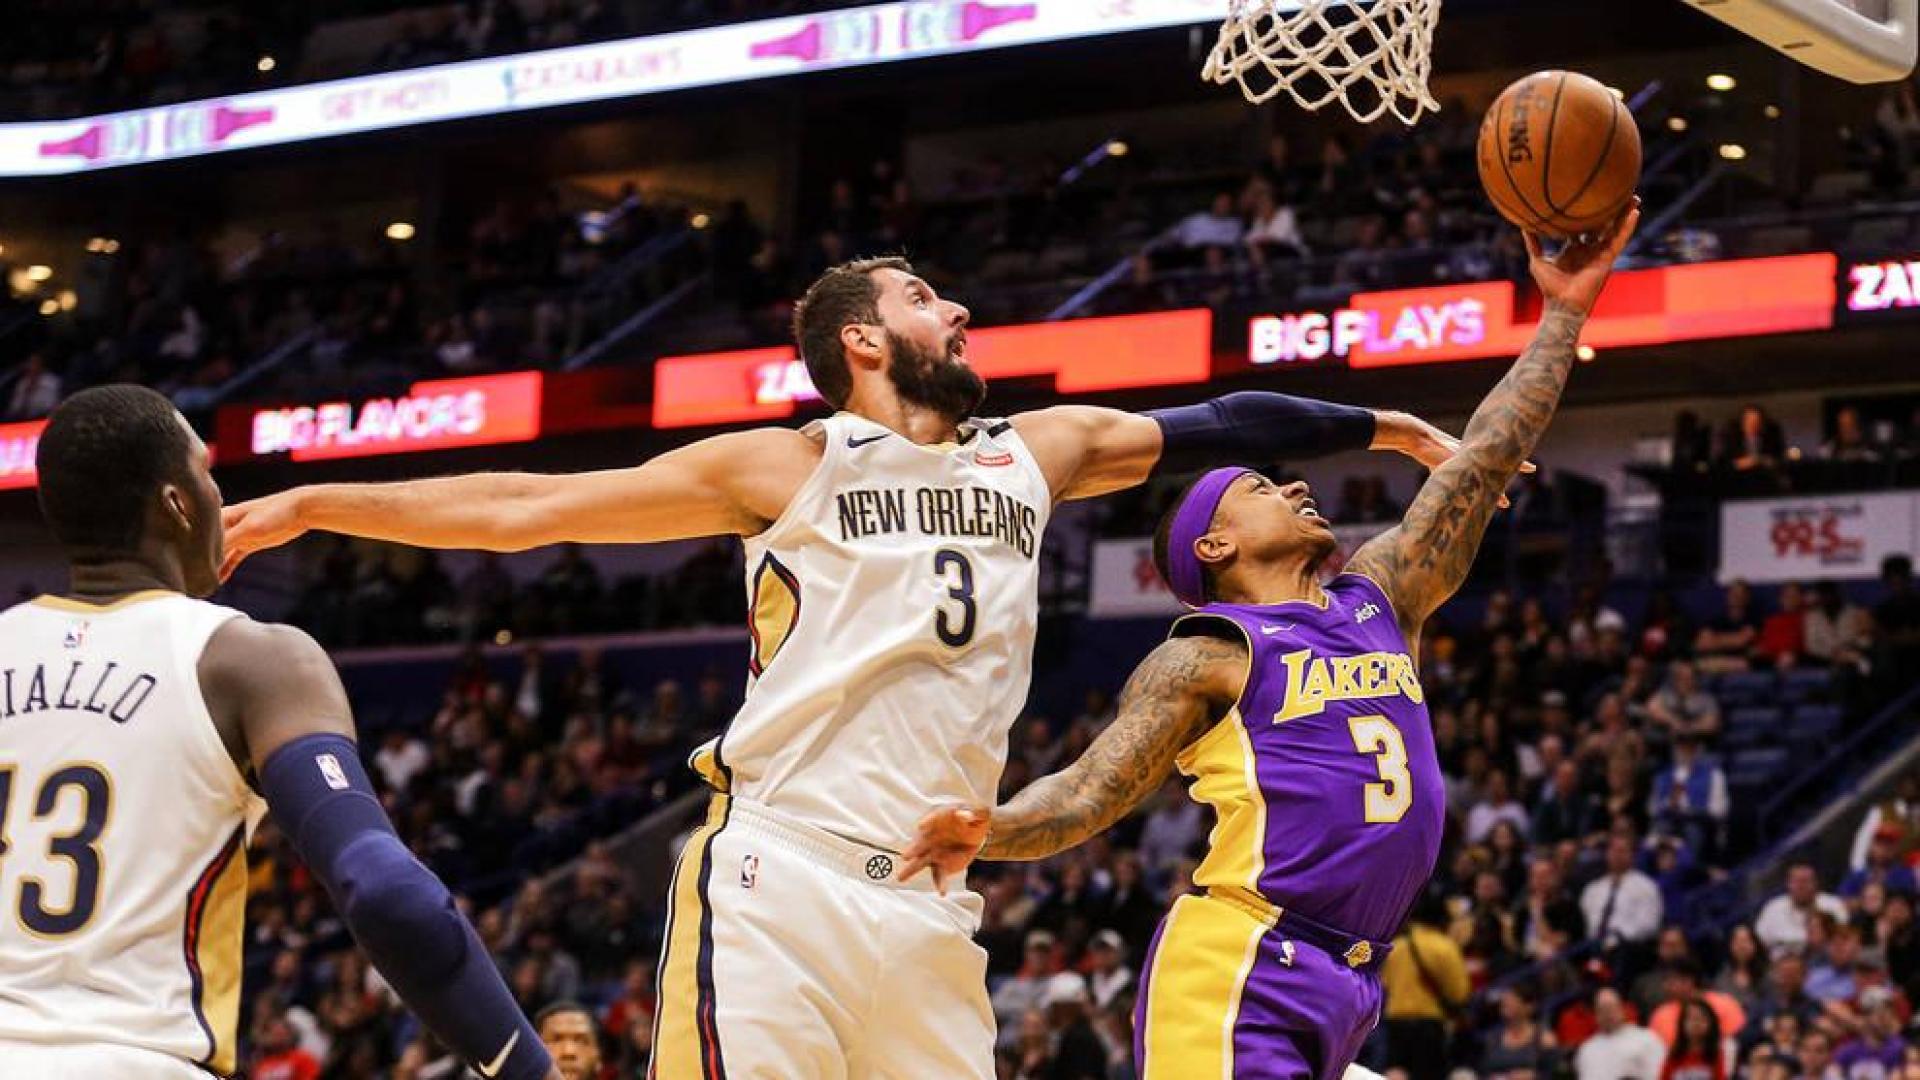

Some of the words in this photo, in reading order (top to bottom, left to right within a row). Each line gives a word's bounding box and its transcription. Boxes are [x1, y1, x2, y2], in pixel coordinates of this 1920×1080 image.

[1250, 312, 1330, 363] BIG
[1332, 297, 1484, 358] PLAYS
[756, 360, 822, 404] ZA
[251, 407, 314, 454] BIG
[315, 391, 487, 446] FLAVORS
[836, 487, 907, 541] NEW
[915, 486, 1036, 560] ORLEANS
[933, 547, 977, 648] 3
[0, 660, 157, 724] IALLO
[1272, 649, 1424, 724] LAKERS
[1347, 714, 1413, 823] 3
[0, 760, 115, 941] 3
